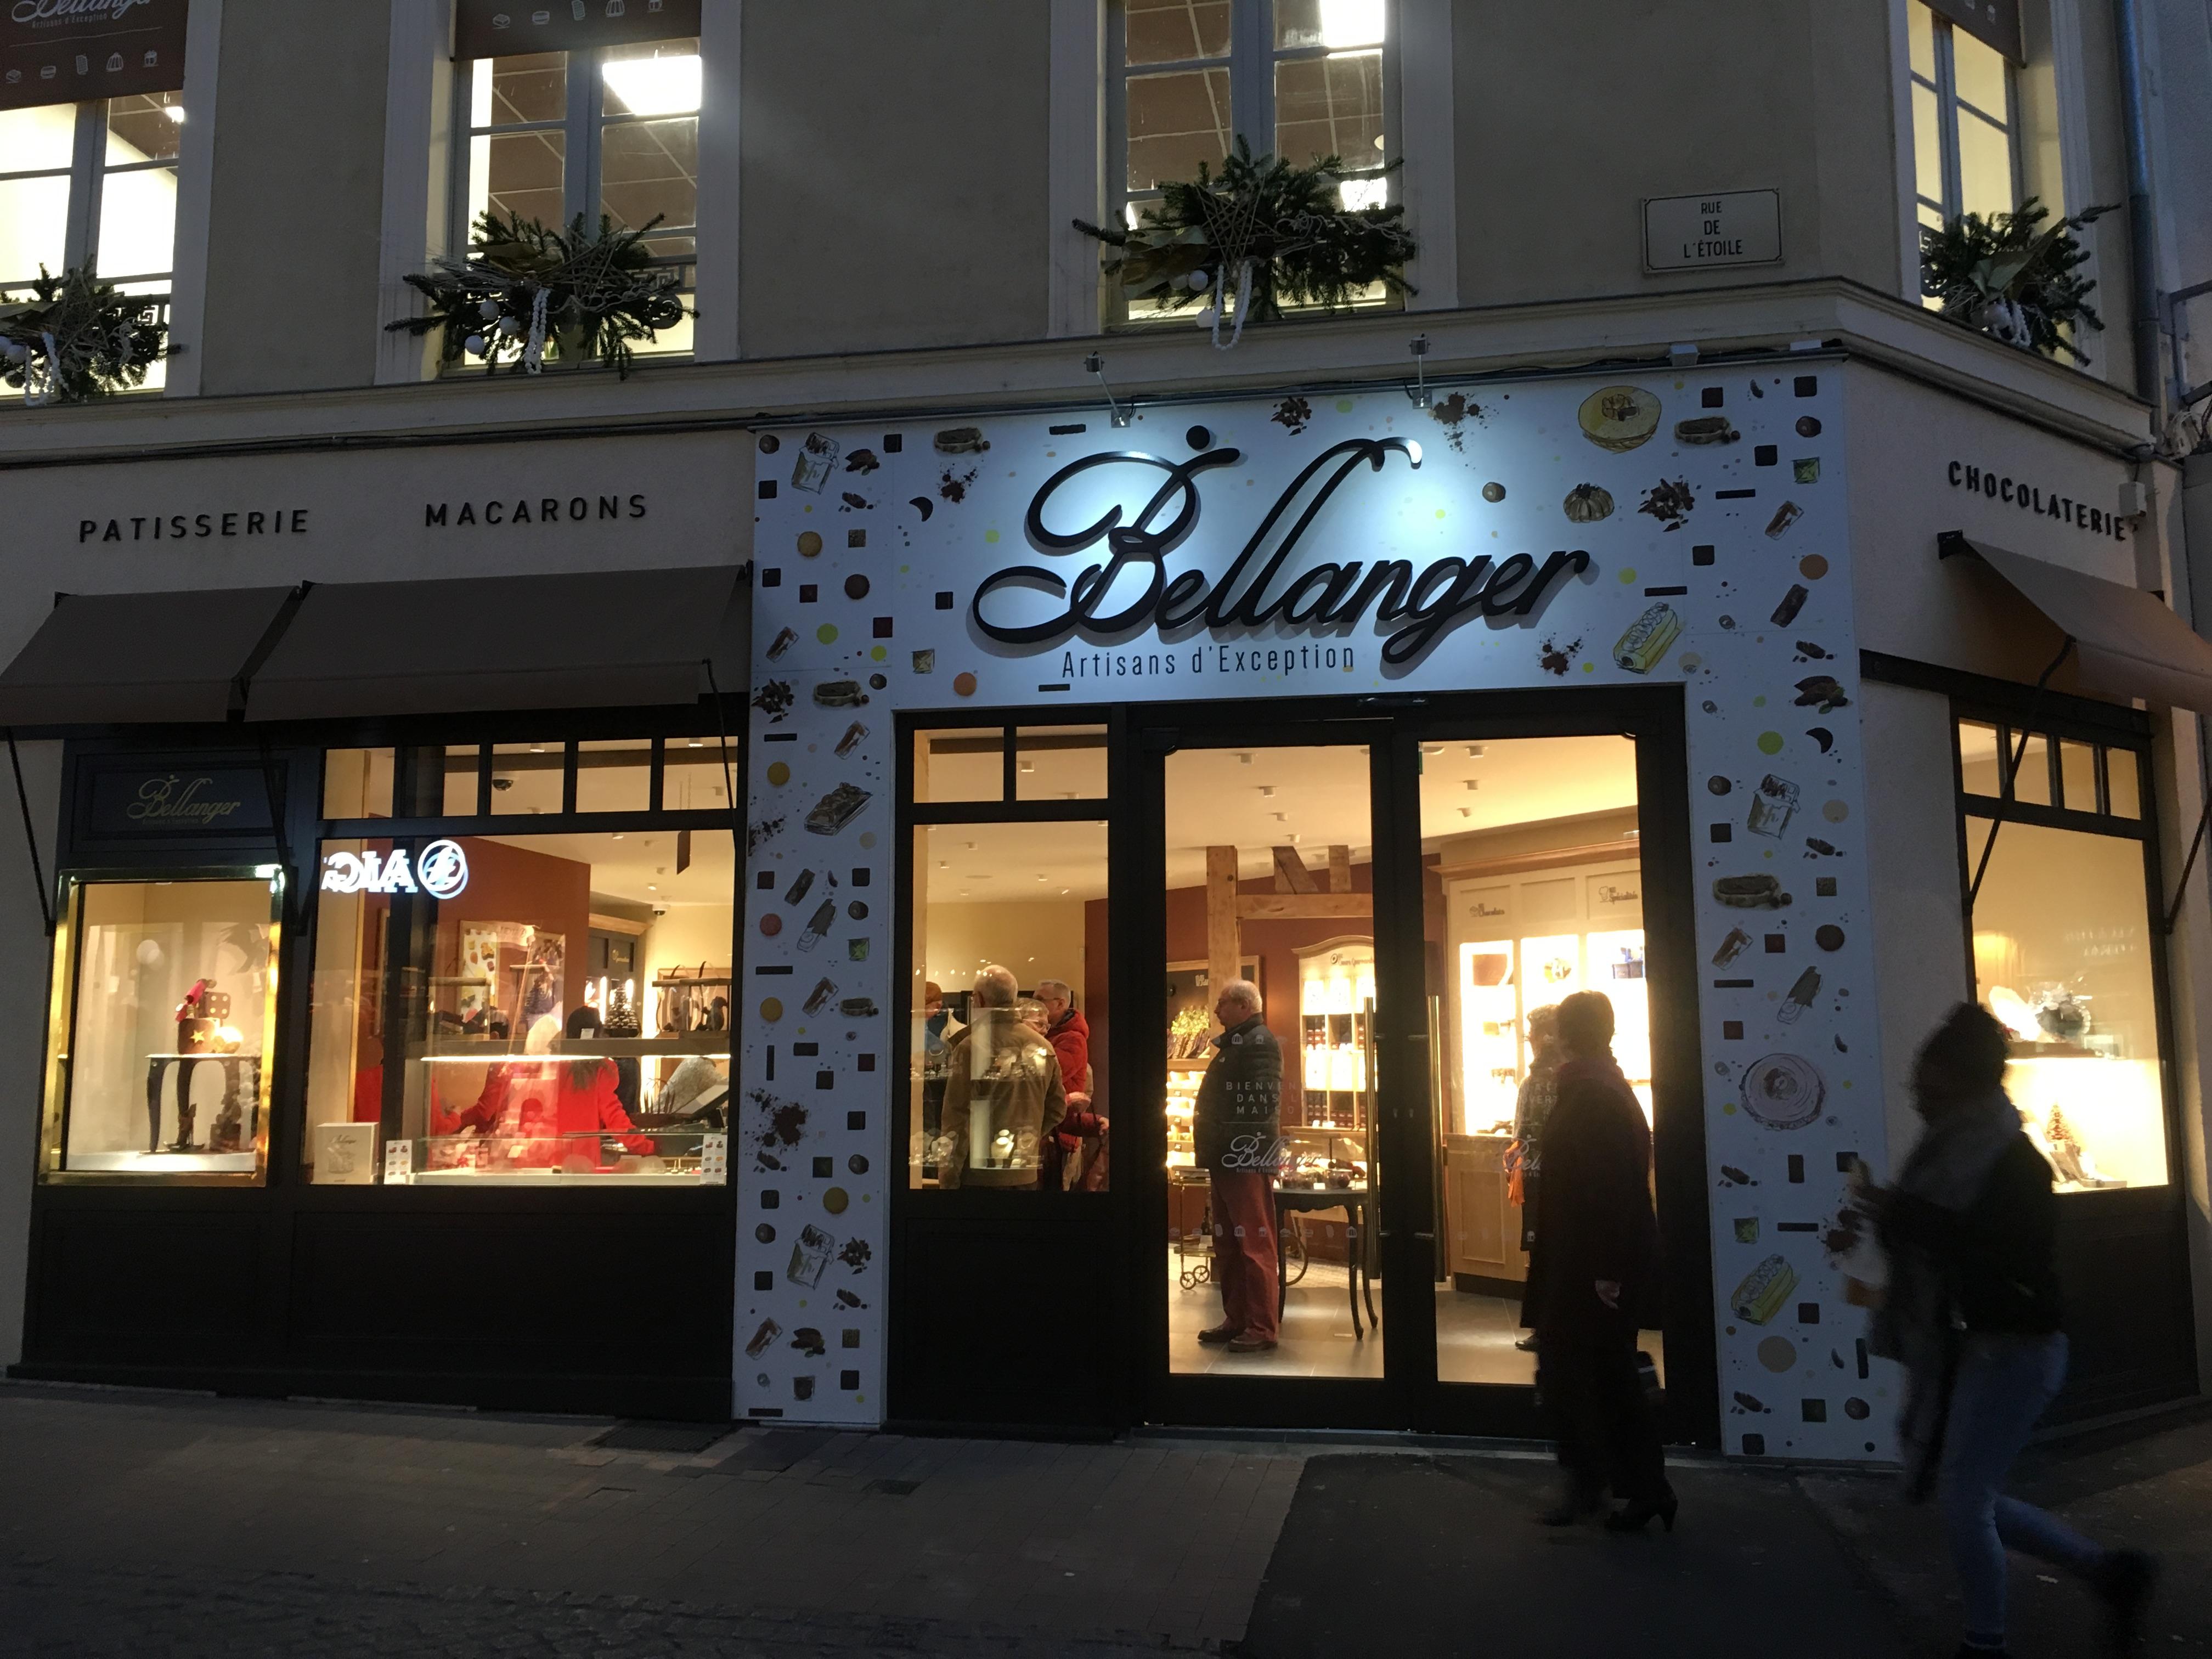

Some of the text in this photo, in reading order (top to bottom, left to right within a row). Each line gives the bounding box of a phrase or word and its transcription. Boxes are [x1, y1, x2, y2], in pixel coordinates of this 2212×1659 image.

[1701, 201, 1722, 214] RUE
[1704, 220, 1720, 235] DE
[1684, 240, 1743, 258] L'ÉTOILE
[425, 494, 646, 527] MACARONS
[1948, 461, 2126, 541] CHOCOLATERIE
[79, 510, 308, 543] PATISSERIE
[973, 426, 1590, 664] Bellanger
[1062, 645, 1353, 678] Artisans d'Exception
[127, 774, 241, 825] Bellanger
[1226, 1081, 1307, 1091] BIENVEN
[1237, 1094, 1279, 1103] DANS
[1237, 1106, 1297, 1114] MAISO
